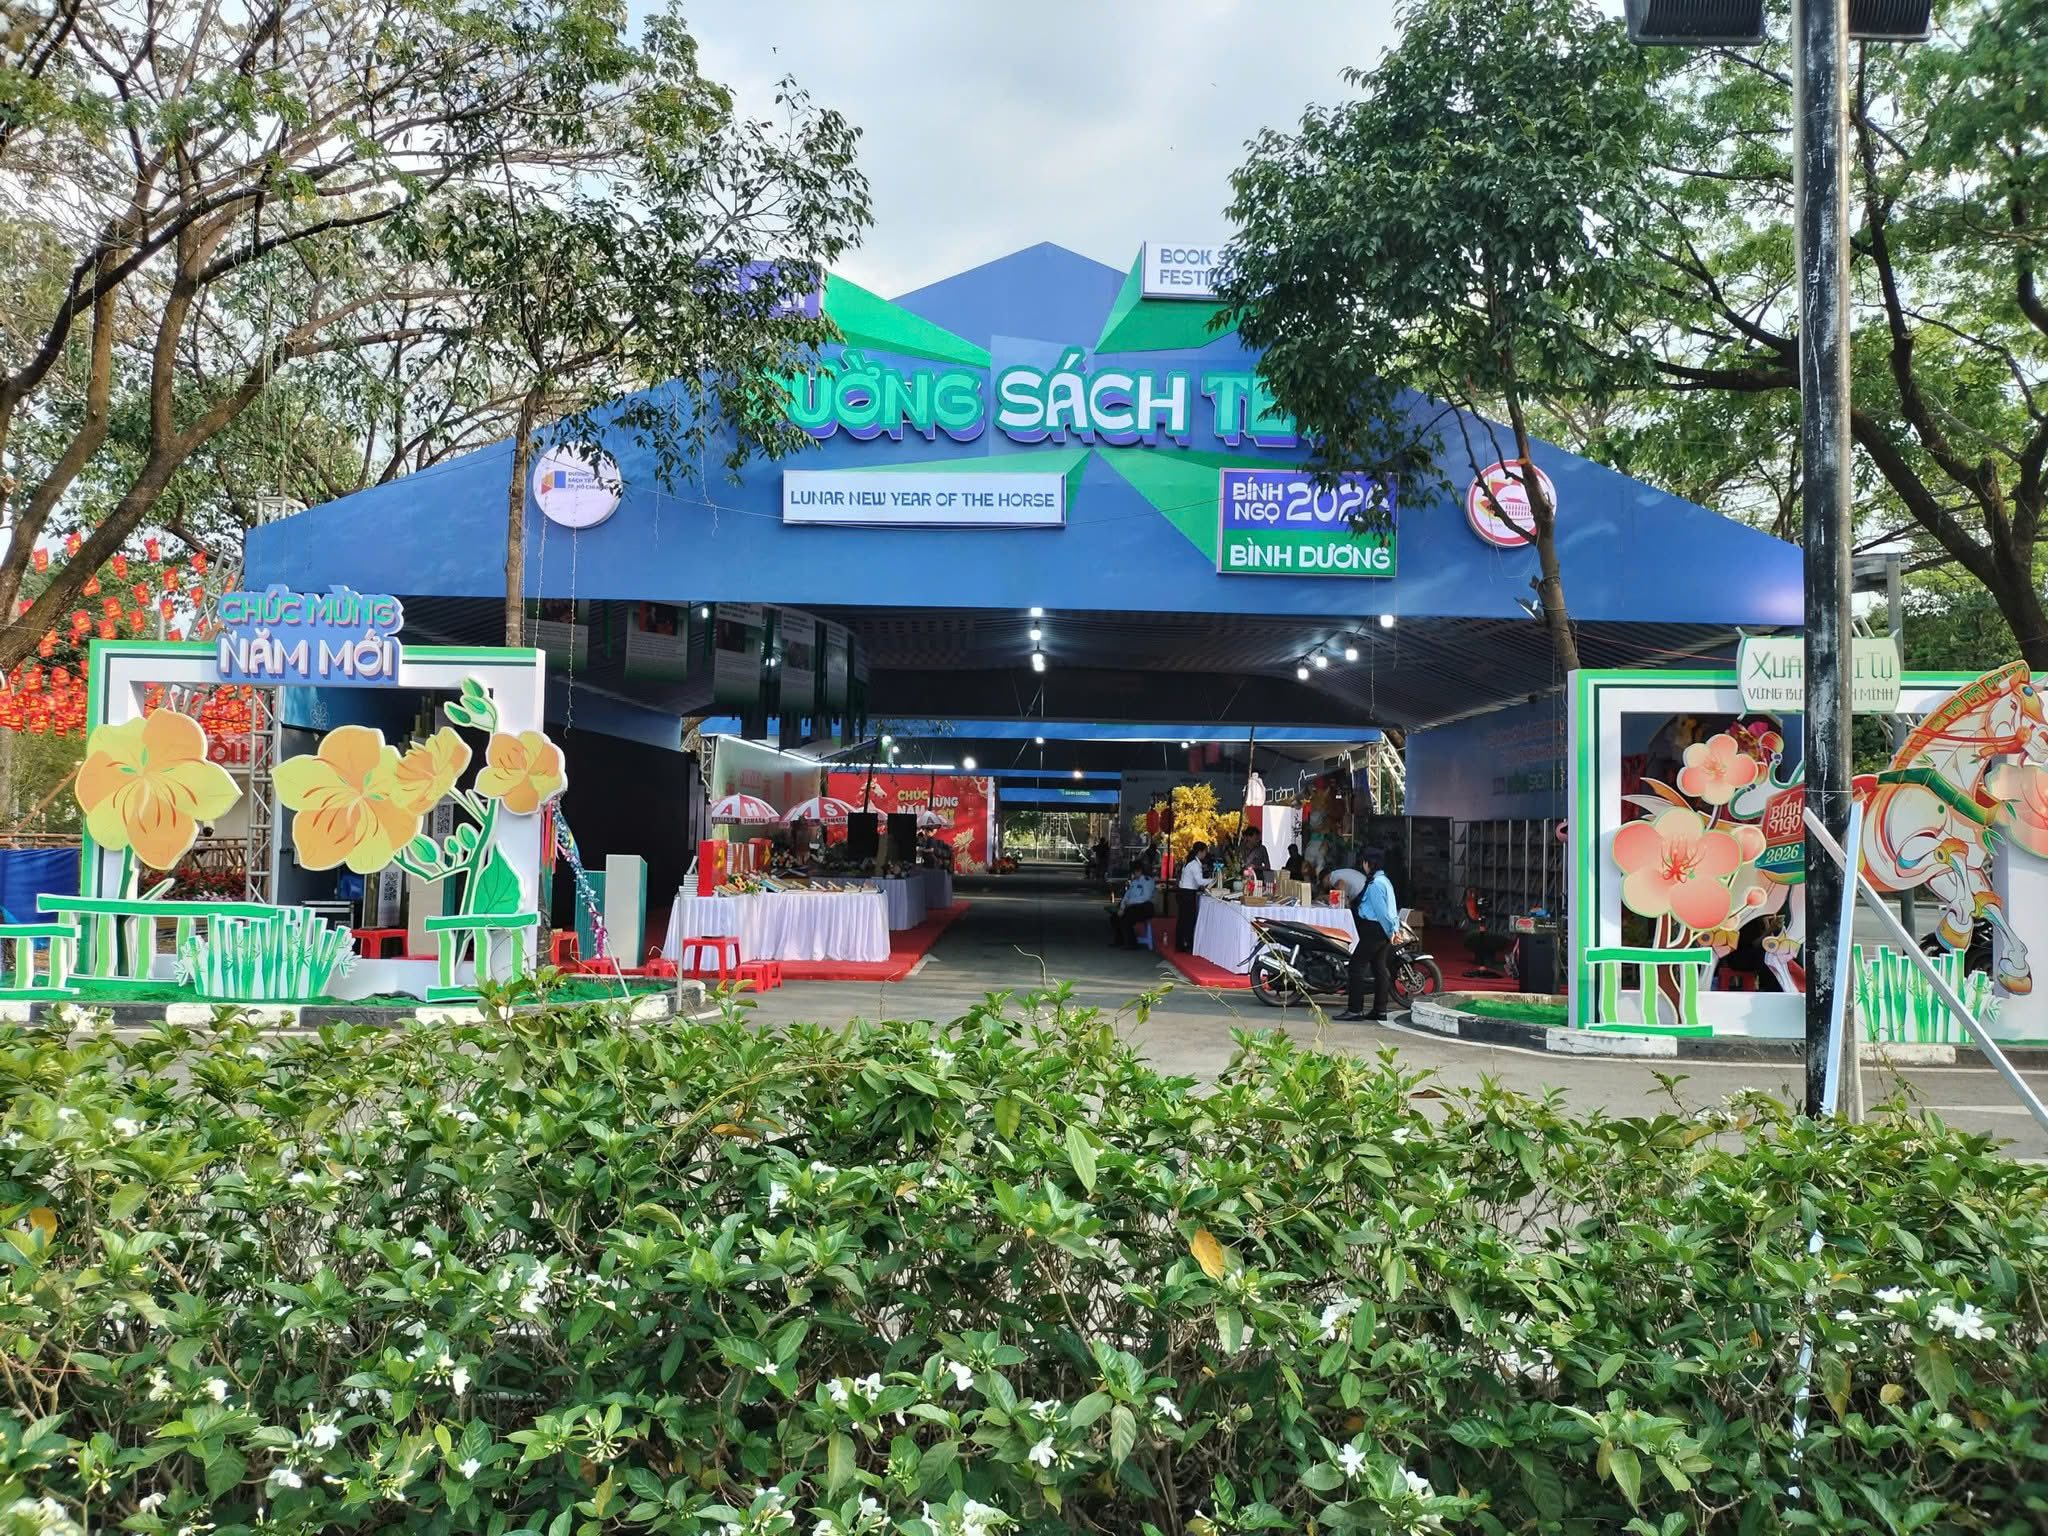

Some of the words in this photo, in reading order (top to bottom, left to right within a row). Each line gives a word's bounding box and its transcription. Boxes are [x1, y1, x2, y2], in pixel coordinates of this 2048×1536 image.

[1160, 248, 1212, 265] BOOK
[764, 350, 982, 434] ƯỜNG
[995, 348, 1190, 438] SÁCH
[790, 491, 845, 505] LUNAR
[849, 491, 886, 506] NEW
[891, 492, 932, 506] YEAR
[935, 493, 957, 506] OF
[962, 493, 994, 507] THE
[998, 493, 1055, 508] HORSE
[1232, 477, 1283, 501] BÍNH
[1234, 502, 1281, 524] NGỌ
[1230, 538, 1292, 567] BÌNH
[1298, 543, 1391, 570] DƯƠNG
[222, 591, 301, 625] CHÚC
[307, 591, 396, 626] MỪNG
[220, 627, 309, 675] NĂM
[318, 628, 393, 676] MỚI
[1748, 651, 1805, 681] XUÂ
[898, 788, 929, 801] CHÚC
[1764, 844, 1800, 864] 2026
